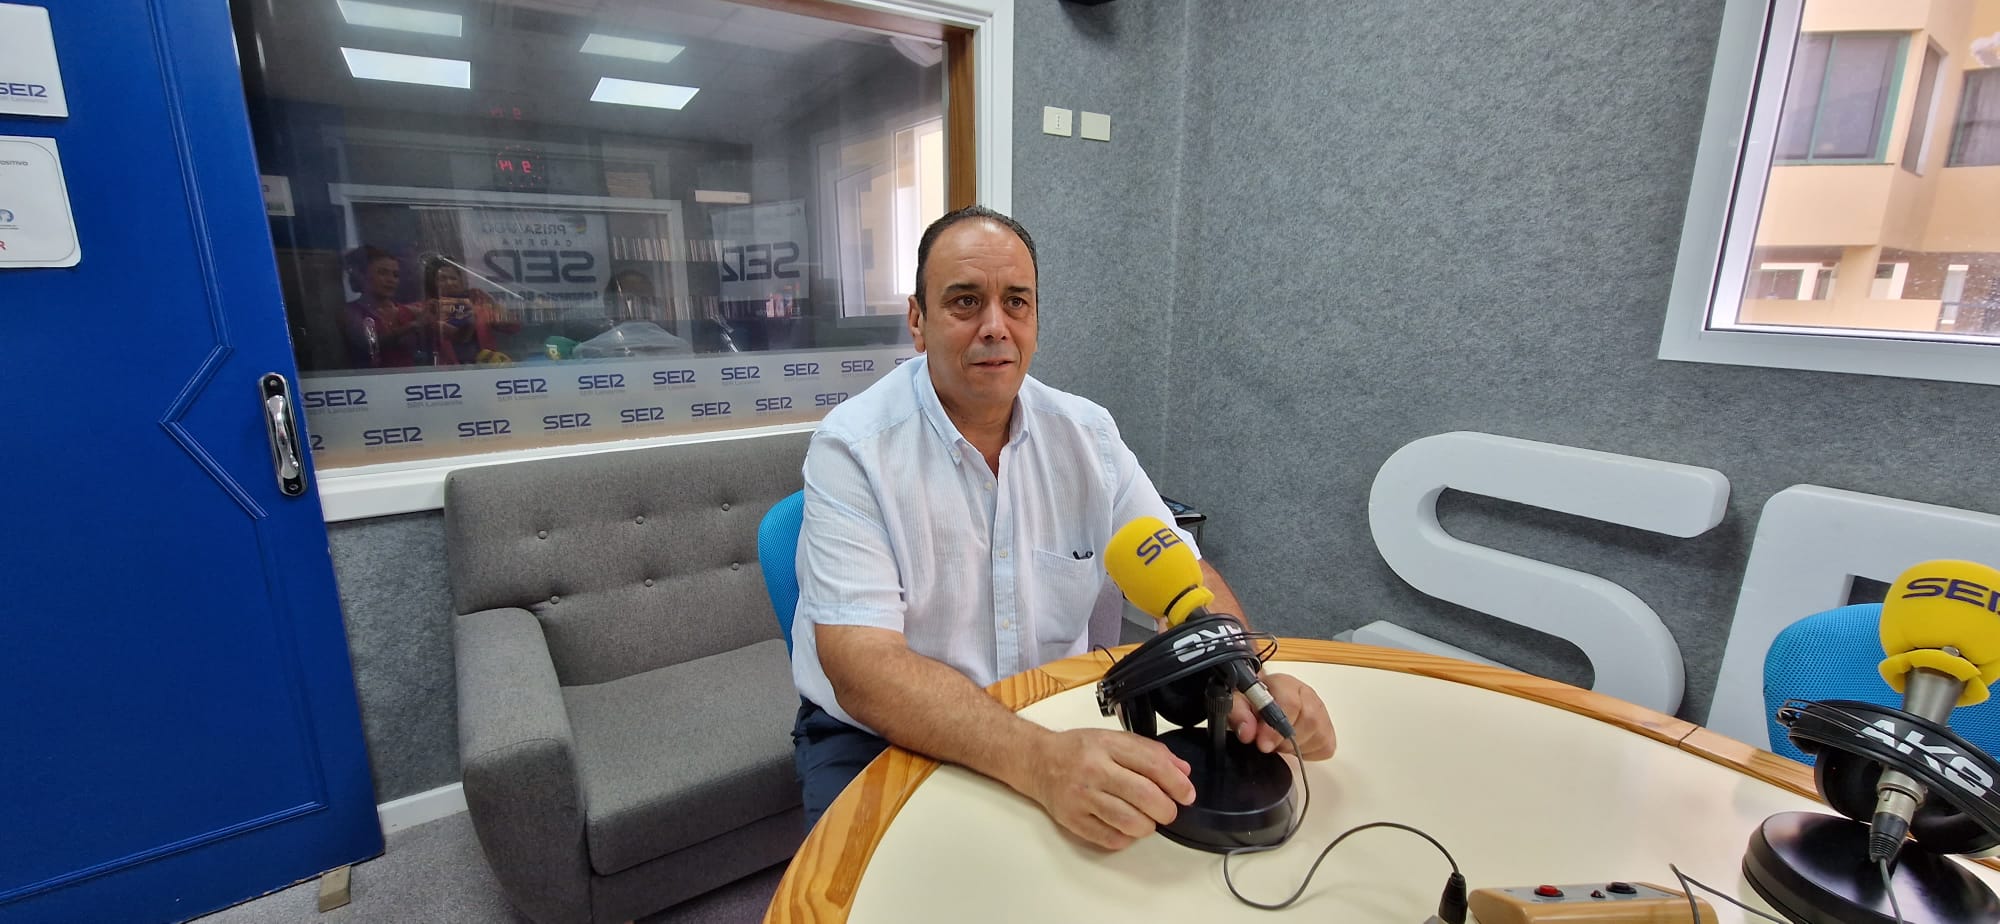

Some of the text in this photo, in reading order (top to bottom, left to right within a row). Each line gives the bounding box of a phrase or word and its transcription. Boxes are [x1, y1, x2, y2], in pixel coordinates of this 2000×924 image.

[304, 388, 368, 409] SER
[405, 383, 462, 402] SER
[496, 378, 548, 396] SER
[578, 373, 625, 390] SER
[652, 369, 696, 385] SER
[721, 366, 760, 381] SER
[783, 362, 820, 377] SER
[841, 359, 875, 373] SER
[363, 426, 423, 446] SER
[458, 419, 512, 438] SER
[543, 412, 592, 430] SER
[620, 407, 664, 423] SER
[691, 401, 732, 417] SER
[755, 396, 793, 411] SER
[1136, 528, 1184, 566] SE
[1856, 719, 1994, 798] AKG
